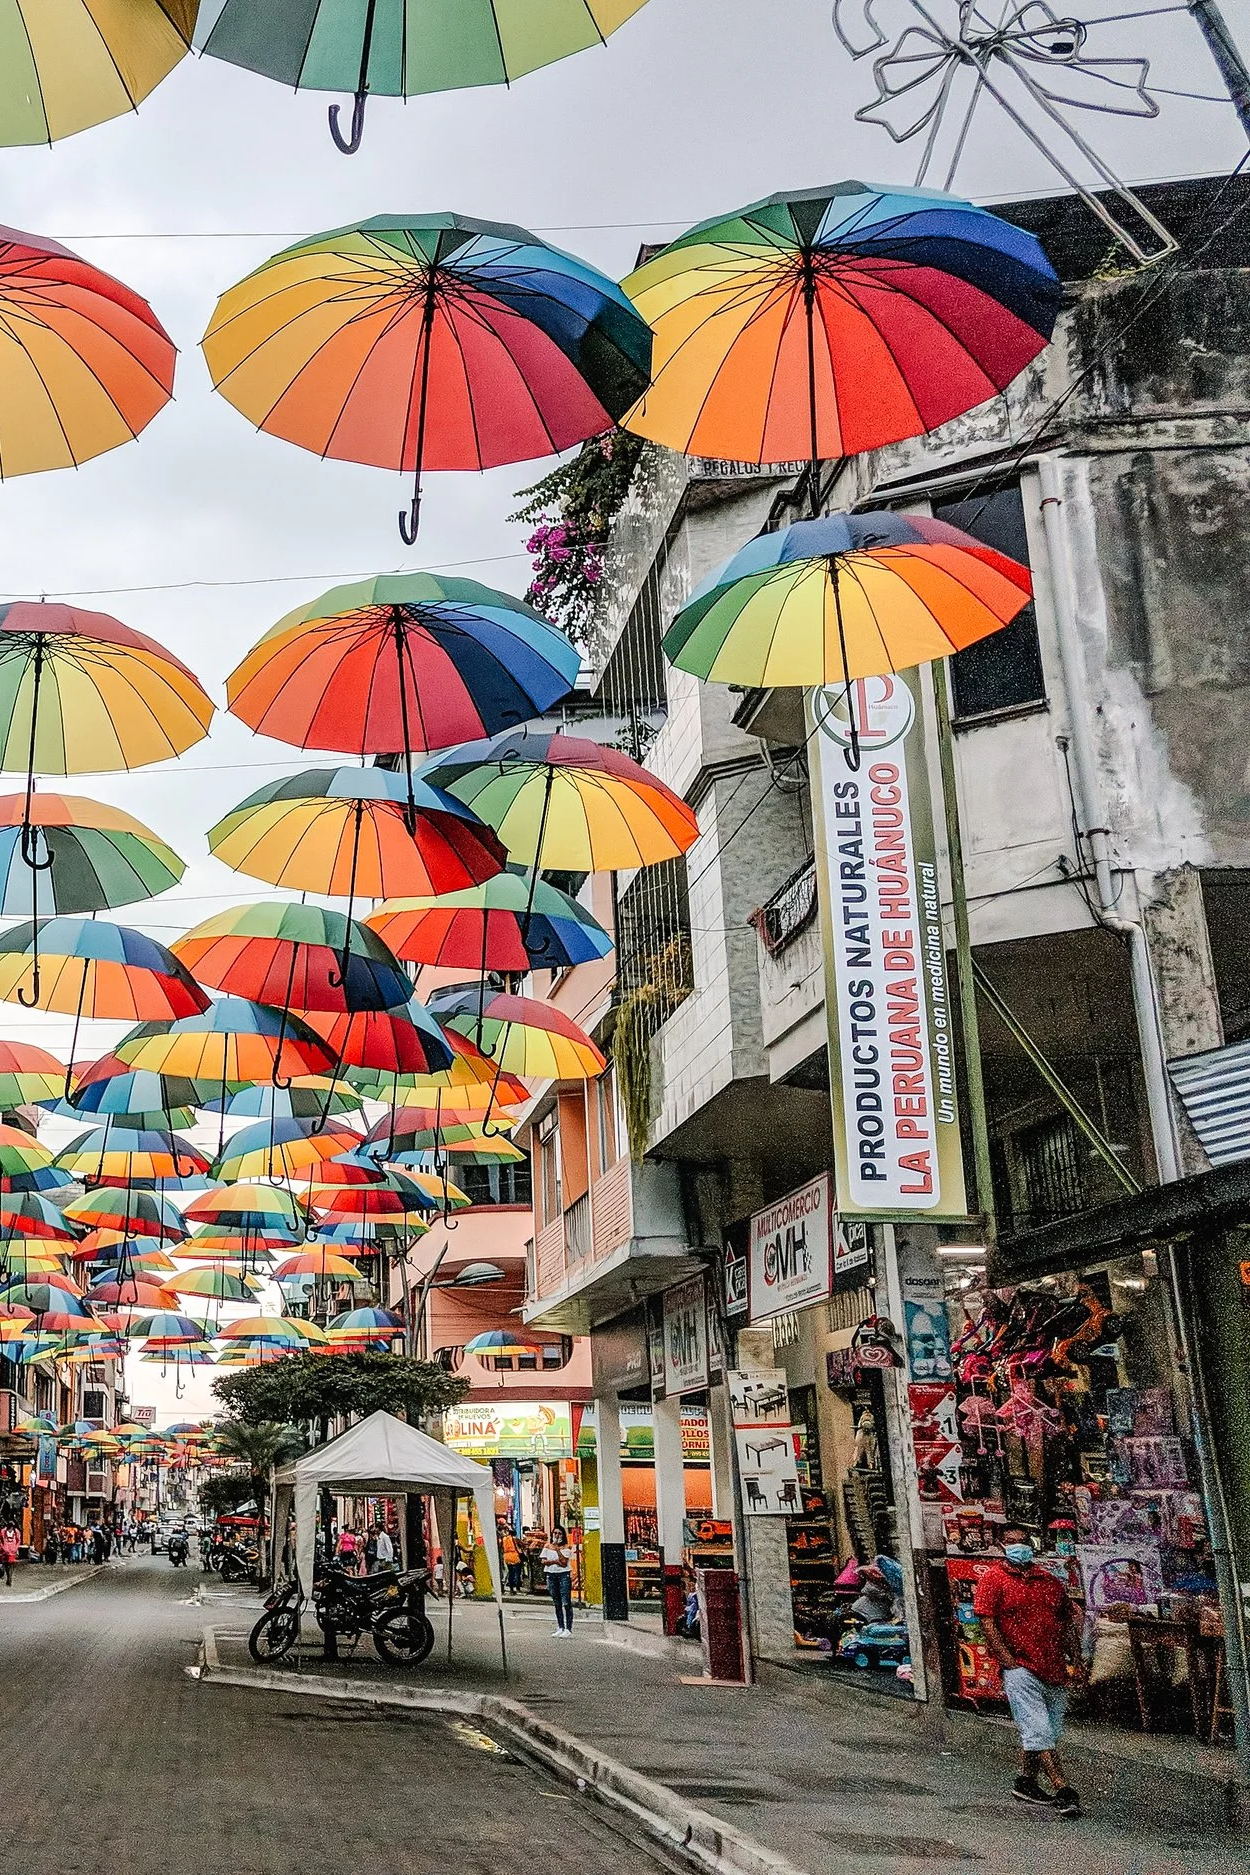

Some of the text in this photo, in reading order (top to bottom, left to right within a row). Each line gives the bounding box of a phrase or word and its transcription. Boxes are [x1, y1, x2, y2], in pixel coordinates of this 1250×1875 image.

[833, 780, 888, 1181] PRODUCTOS NATURALES
[868, 761, 934, 1195] LA PERUANA DE HUÁNUCO
[917, 861, 956, 1124] Un mundo en medicina natural
[756, 1186, 821, 1240] MULTICOMERCIO
